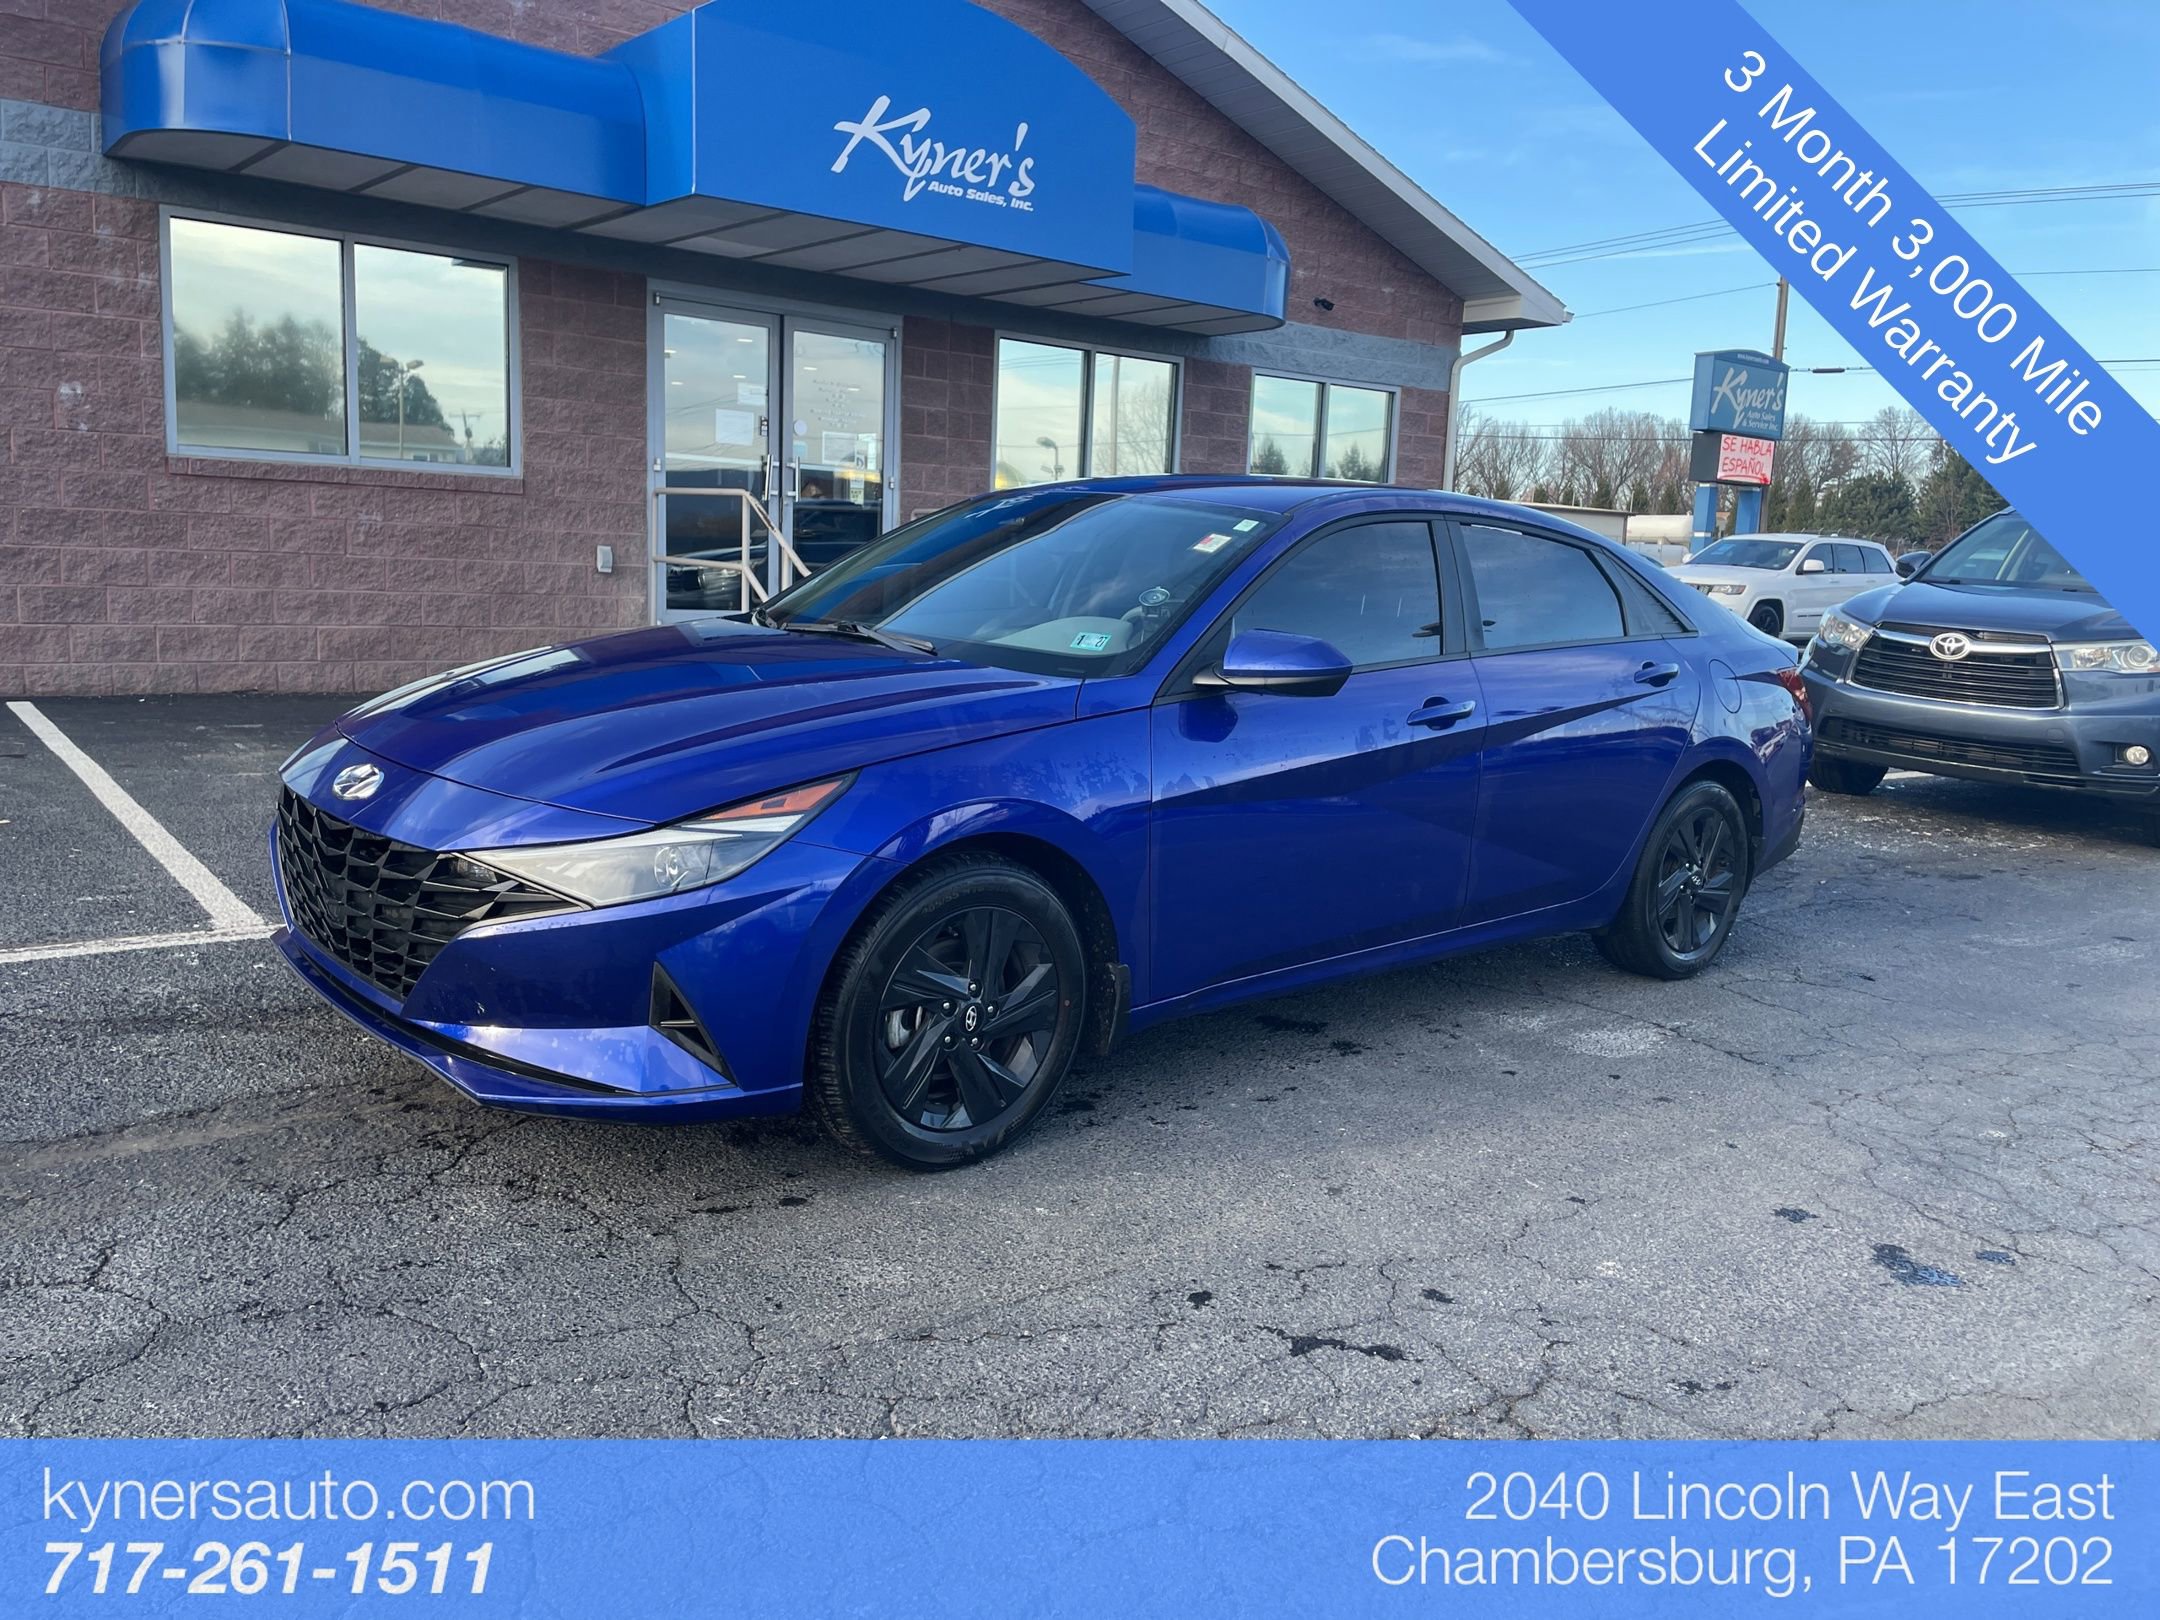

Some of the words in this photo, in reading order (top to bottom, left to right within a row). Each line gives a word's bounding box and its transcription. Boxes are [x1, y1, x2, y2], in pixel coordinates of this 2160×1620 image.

[831, 95, 1036, 202] Kyner's
[928, 181, 963, 198] Auto
[965, 188, 1007, 208] Sales,
[1010, 197, 1034, 212] Inc.
[1711, 367, 1784, 429] Kyner's
[1722, 437, 1737, 452] SE
[1741, 440, 1772, 456] HABLA
[1722, 457, 1765, 476] ESPAÑOL
